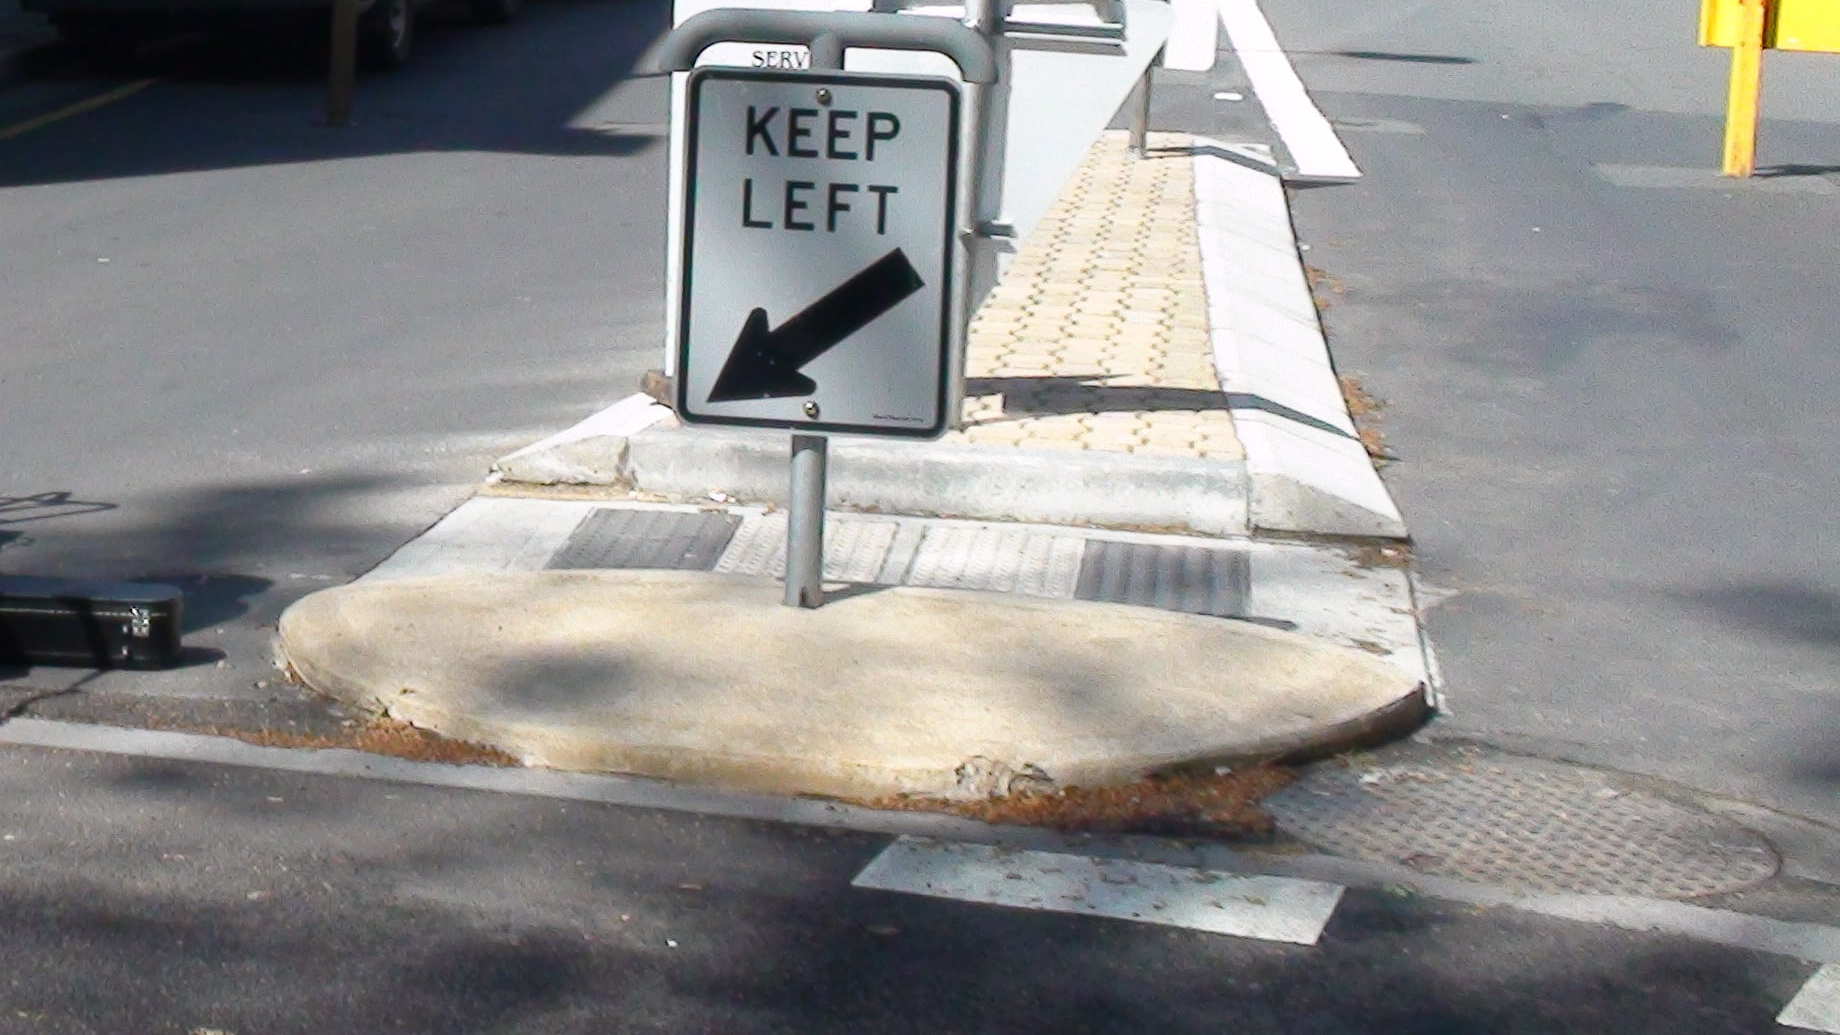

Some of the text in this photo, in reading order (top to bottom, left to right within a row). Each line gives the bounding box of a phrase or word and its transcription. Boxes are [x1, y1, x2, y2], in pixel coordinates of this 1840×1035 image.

[752, 51, 810, 69] SERV
[745, 105, 901, 161] KEEP
[742, 178, 898, 235] LEFT
